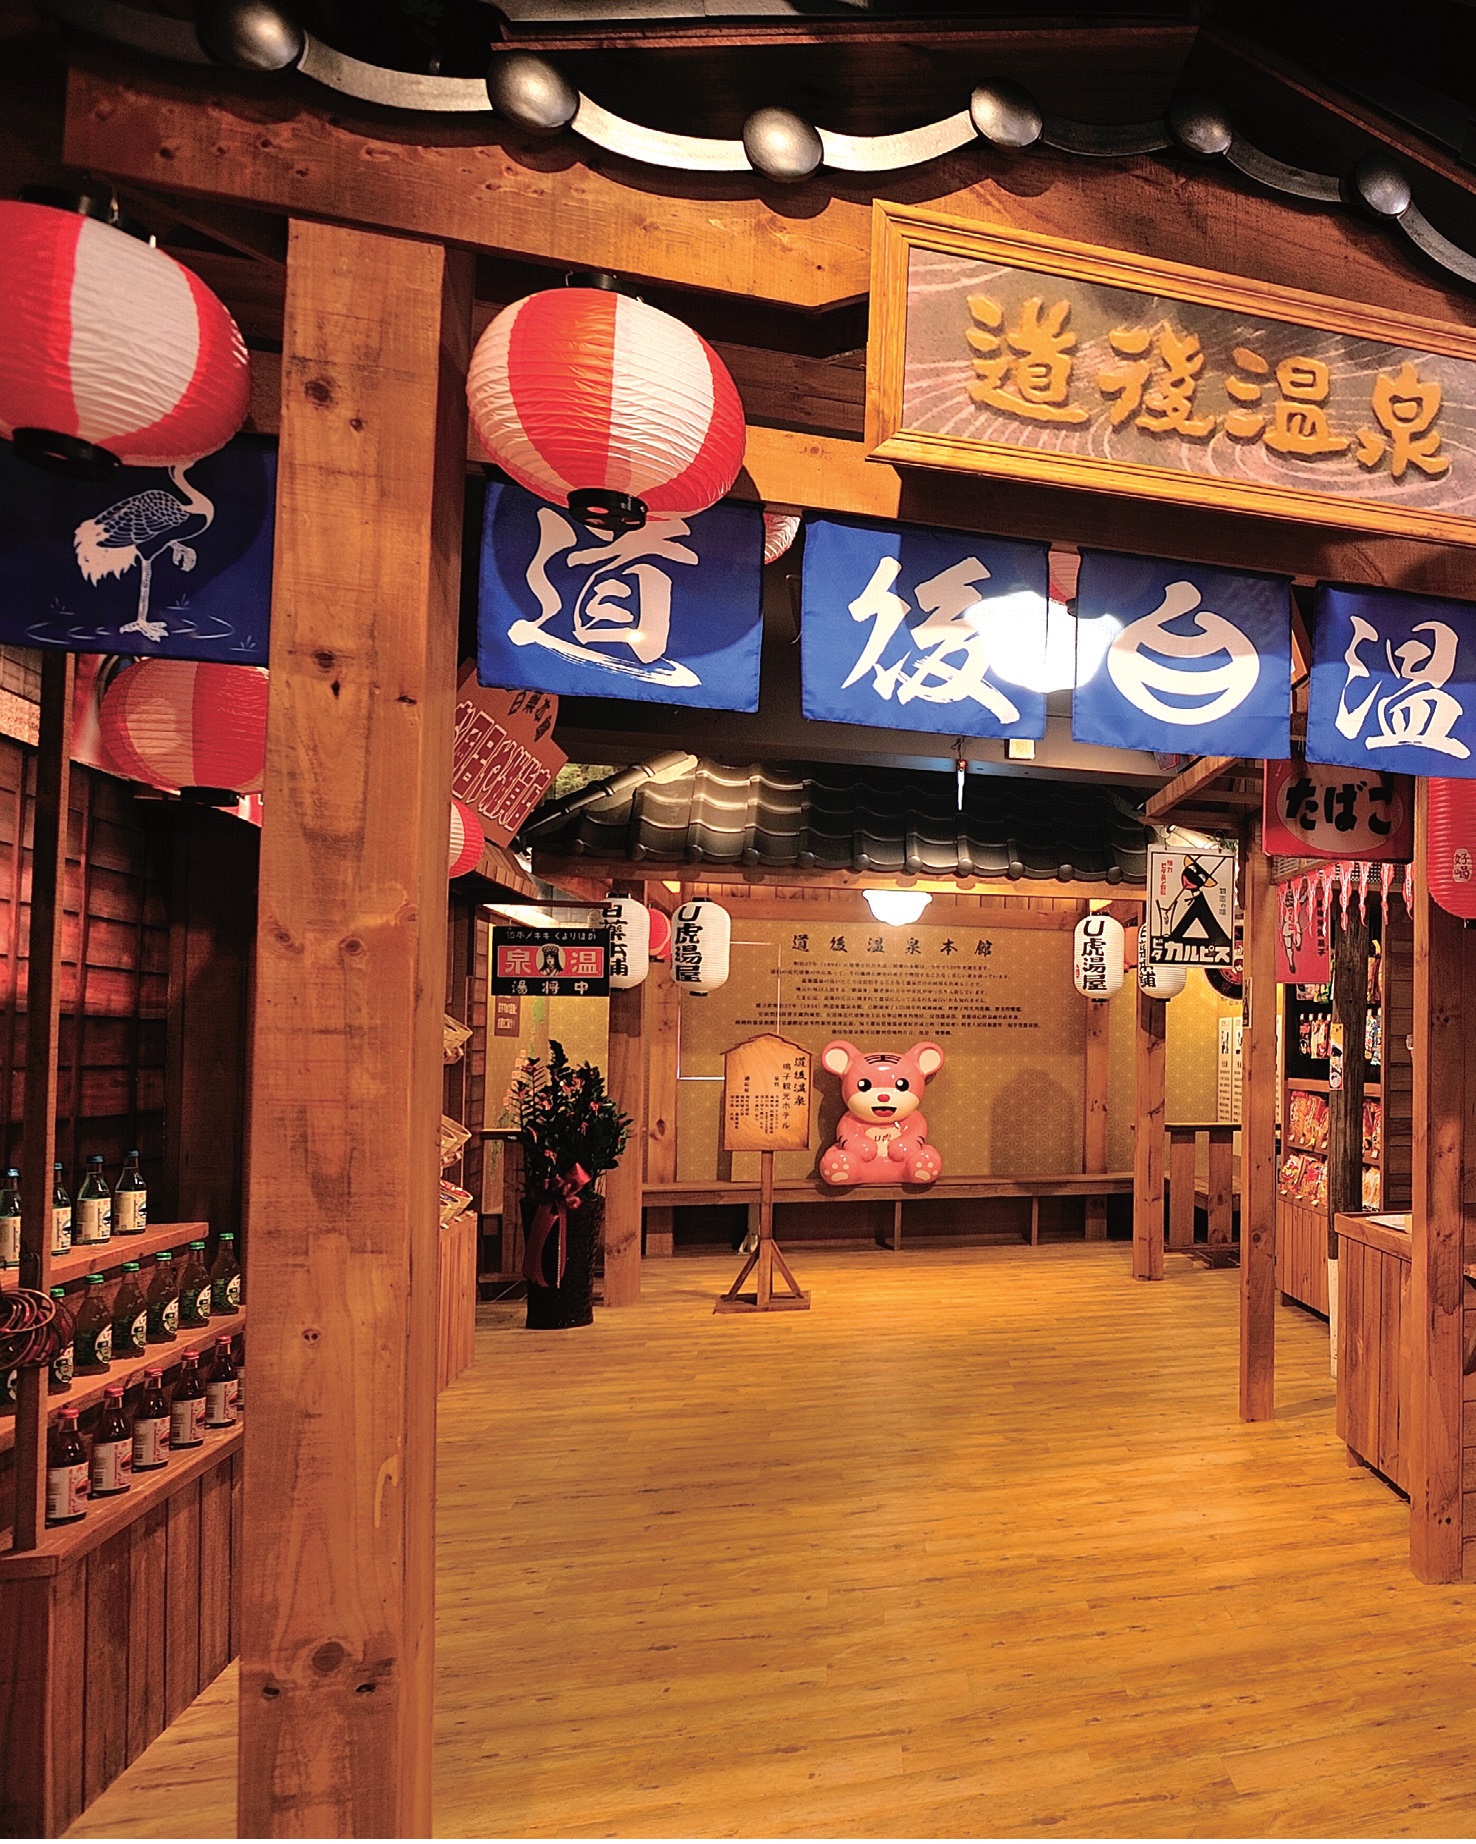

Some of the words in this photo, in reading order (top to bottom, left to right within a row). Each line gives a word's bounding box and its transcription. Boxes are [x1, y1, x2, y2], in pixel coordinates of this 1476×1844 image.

[964, 292, 1454, 484] 道後温泉
[506, 505, 703, 690] 道
[840, 553, 1023, 726] 後
[1332, 615, 1472, 762] 温
[1285, 777, 1393, 836] たばこ
[1081, 919, 1108, 991] U虎湯屋
[1164, 940, 1232, 963] カルピス
